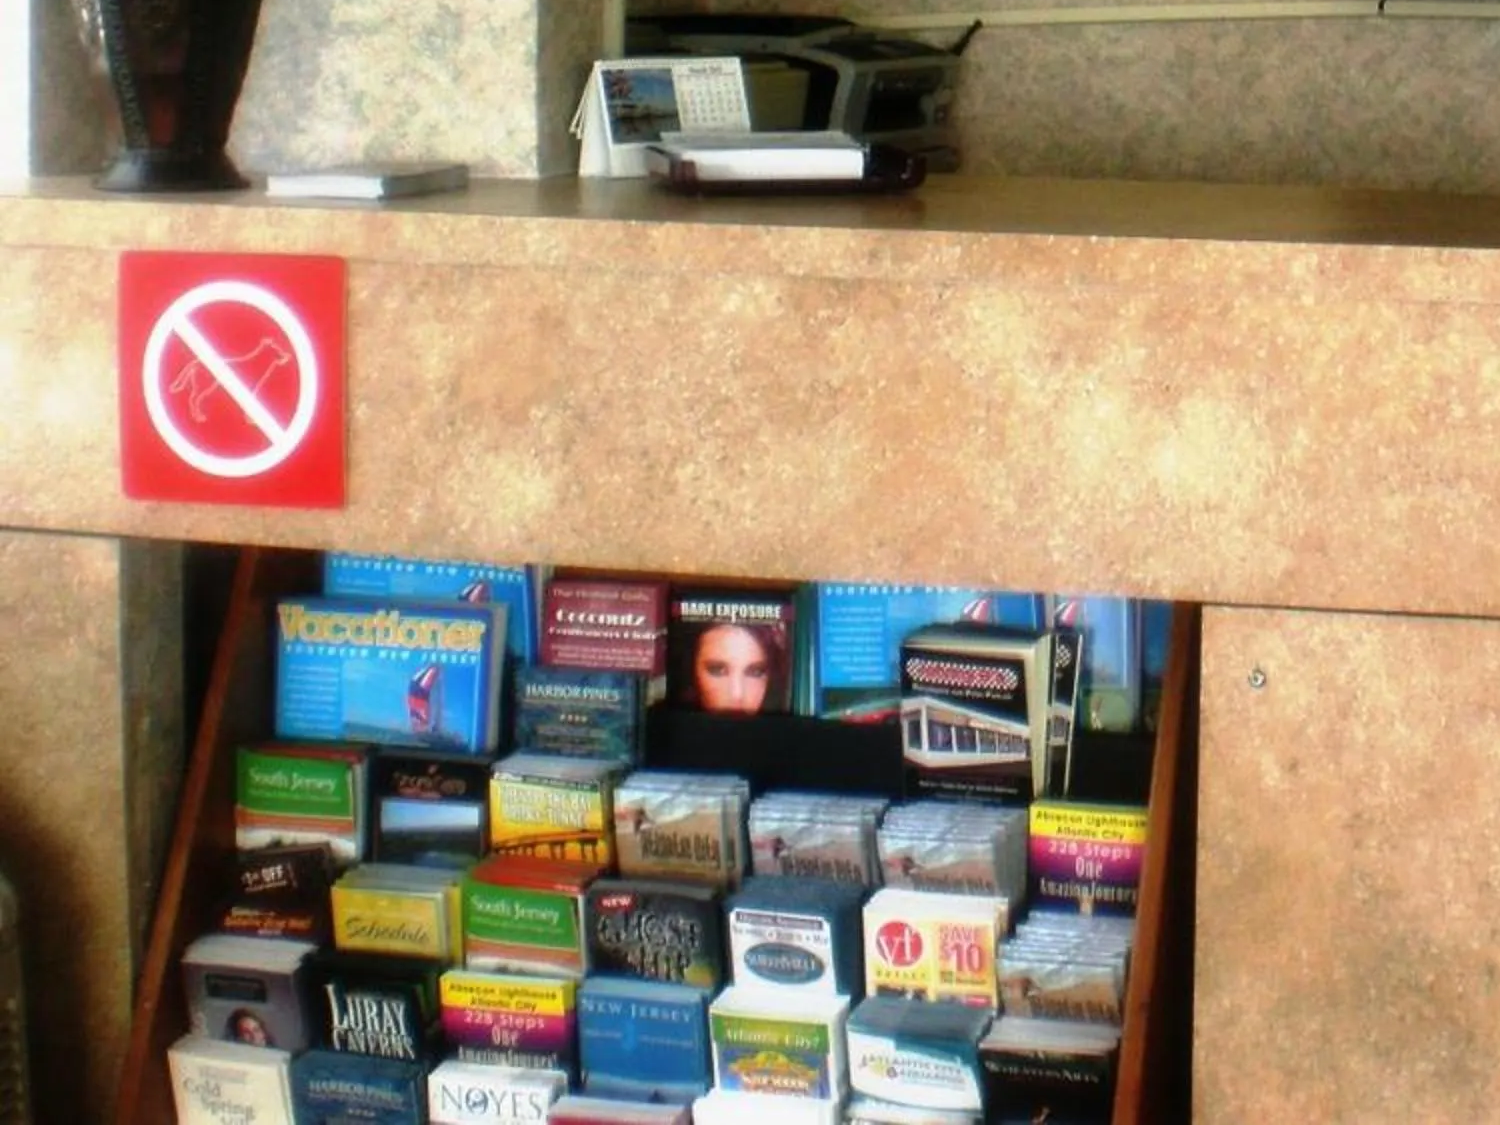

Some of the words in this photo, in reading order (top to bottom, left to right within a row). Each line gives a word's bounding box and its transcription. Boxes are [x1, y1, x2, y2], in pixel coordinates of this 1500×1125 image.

[426, 565, 458, 577] NEW
[681, 601, 714, 618] BARE
[715, 602, 782, 624] EXPOSURE
[278, 604, 486, 653] Vacationer
[379, 650, 411, 662] NEW
[249, 768, 289, 789] South
[291, 771, 337, 794] Jersey
[1056, 826, 1097, 837] Atlantic
[1101, 829, 1125, 840] City
[1075, 856, 1103, 879] One
[470, 893, 512, 918] South
[513, 902, 561, 925] Jersey
[601, 894, 632, 907] NEW
[939, 923, 984, 941] SAVE
[939, 942, 984, 973] $10
[324, 983, 407, 1037] LURAY
[515, 1001, 538, 1012] City
[581, 997, 623, 1013] NEW
[630, 1002, 691, 1023] JERSEY
[333, 1027, 416, 1060] CAVERNS
[183, 1077, 222, 1098] Cold
[440, 1083, 543, 1121] NOYES
